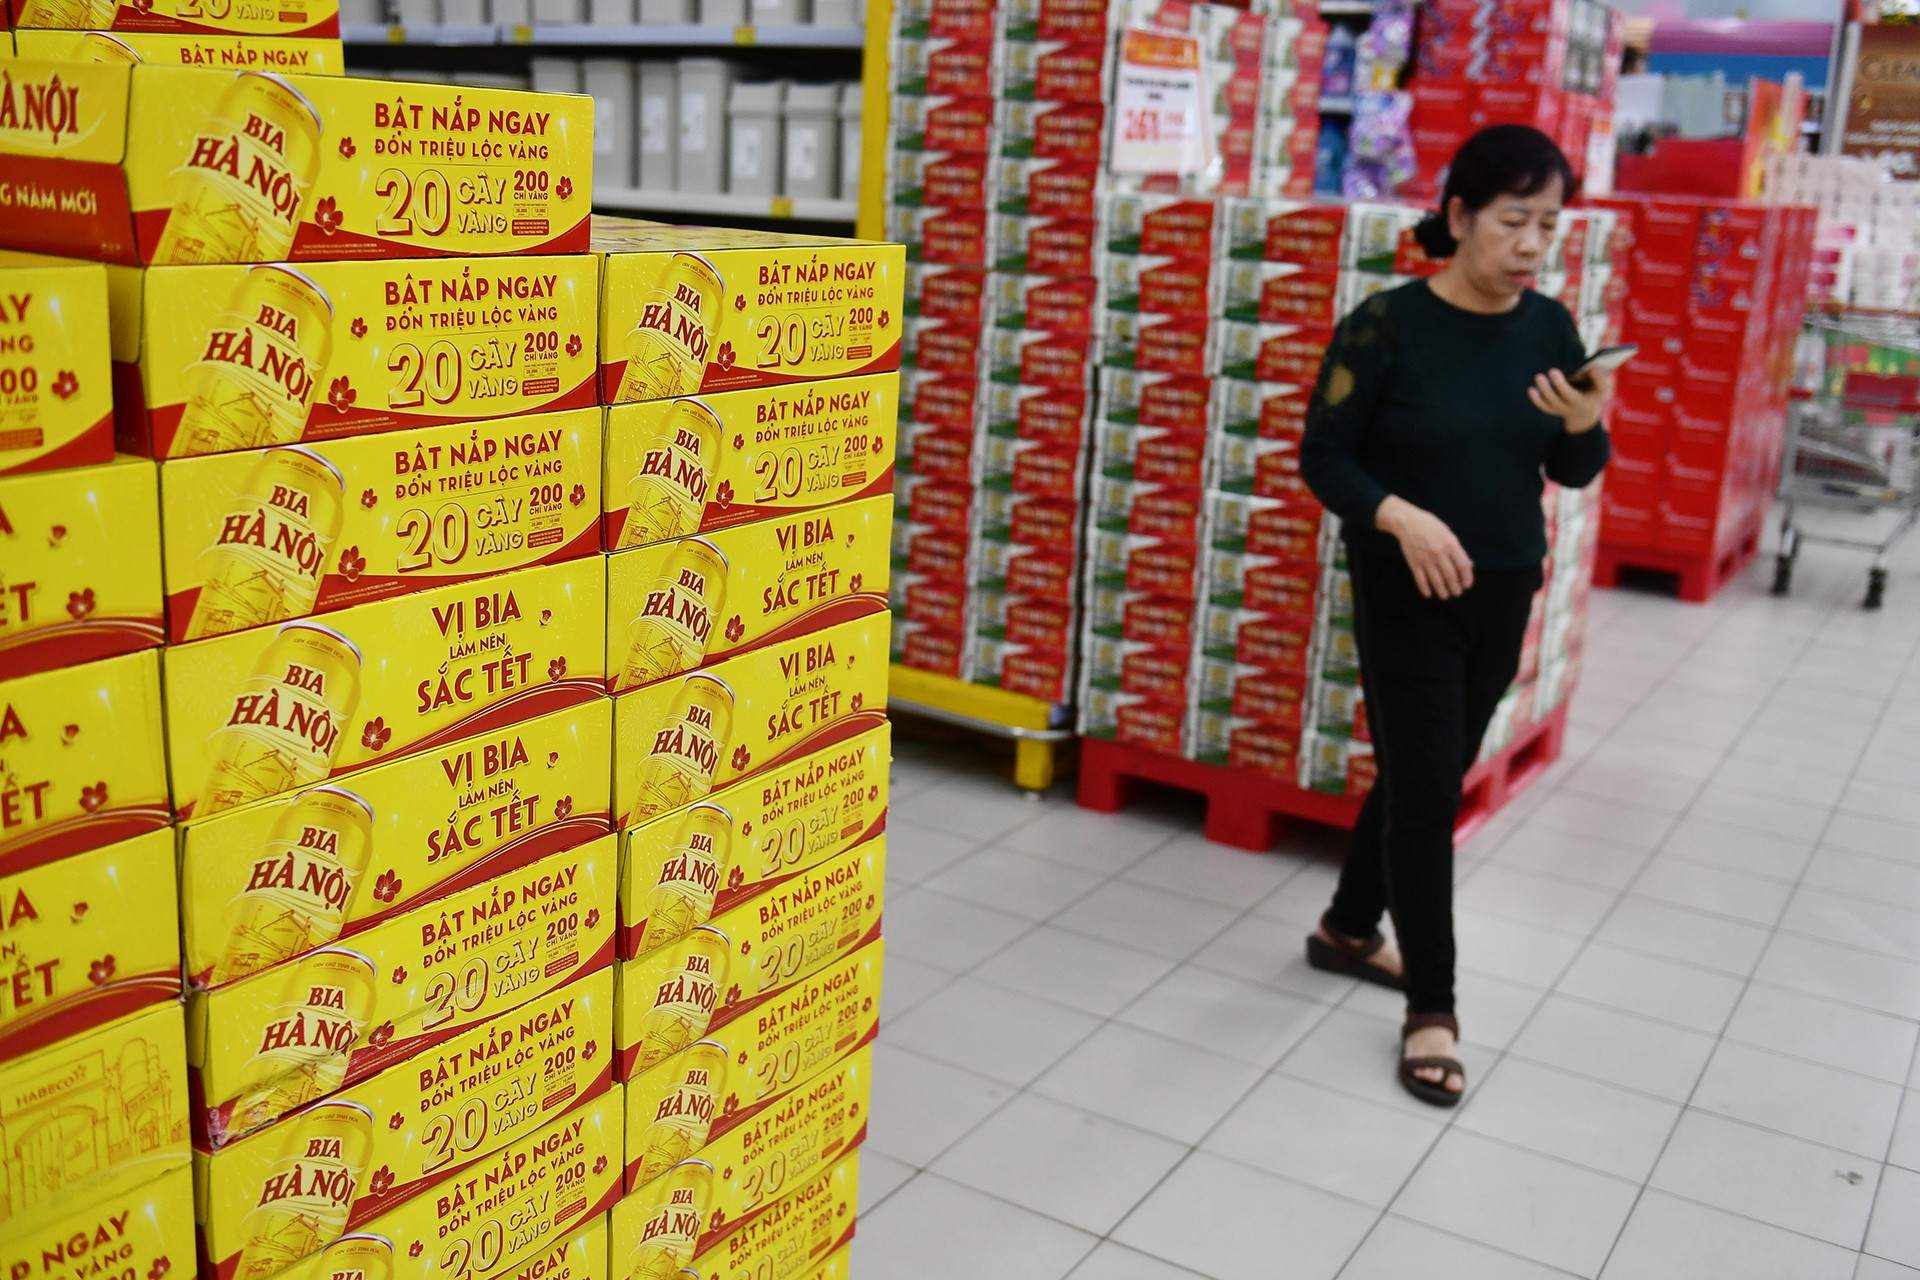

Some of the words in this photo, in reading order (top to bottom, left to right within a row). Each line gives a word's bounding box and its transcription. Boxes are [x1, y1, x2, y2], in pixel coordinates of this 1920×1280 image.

[264, 50, 309, 65] NGAY
[0, 69, 21, 130] À
[23, 72, 80, 146] NỘI
[375, 96, 424, 136] BẬT
[432, 94, 481, 132] NẮP
[488, 110, 550, 136] NGAY
[243, 114, 286, 155] BIA
[374, 134, 412, 155] ĐÓN
[419, 137, 465, 160] TRIỆU
[472, 138, 502, 162] LỘC
[508, 140, 549, 160] VÀNG
[188, 135, 242, 179] HÀ
[244, 155, 303, 223] NỘI
[454, 169, 507, 205] CÂY
[513, 169, 549, 192] 200
[375, 167, 451, 237] 20
[456, 207, 508, 234] VÀNG
[385, 273, 433, 312] BẬT
[442, 266, 490, 303] NẮP
[497, 275, 558, 300] NGAY
[759, 259, 791, 290] BẬT
[796, 254, 829, 283] NẮP
[833, 261, 876, 281] NGAY
[674, 284, 702, 312] BIA
[758, 289, 782, 305] ĐÓN
[787, 287, 818, 305] TRIỆU
[822, 286, 842, 304] LỘC
[846, 284, 874, 299] VÀNG
[256, 305, 299, 341] BIA
[385, 310, 423, 331] ĐÓN
[429, 307, 475, 330] TRIỆU
[481, 305, 512, 328] LỘC
[517, 303, 558, 322] VÀNG
[639, 301, 673, 334] HÀ
[674, 315, 710, 364] NỘI
[849, 306, 873, 325] 200
[465, 335, 517, 370] CÂY
[523, 330, 558, 353] 200
[203, 327, 256, 368] HÀ
[258, 344, 316, 405] NỘI
[386, 339, 462, 410] 20
[468, 372, 519, 400] VÀNG
[756, 397, 788, 427] BẬT
[793, 388, 825, 418] NẮP
[829, 390, 870, 413] NGAY
[395, 441, 442, 478] BẬT
[450, 429, 497, 467] NẮP
[504, 429, 564, 459] NGAY
[675, 429, 701, 455] BIA
[395, 477, 431, 499] ĐÓN
[438, 469, 482, 492] TRIỆU
[488, 464, 518, 486] LỘC
[524, 459, 563, 477] VÀNG
[528, 482, 563, 507] 200
[640, 447, 674, 478] HÀ
[674, 459, 709, 504] NỘI
[269, 485, 310, 518] BIA
[472, 493, 523, 528] CÂY
[217, 508, 268, 548] HÀ
[271, 522, 326, 578] NỘI
[396, 502, 469, 574] 20
[474, 529, 524, 557] VÀNG
[775, 524, 796, 554] VỊ
[803, 517, 834, 547] BIA
[785, 558, 803, 571] LÀM
[805, 552, 822, 566] NÊN
[678, 569, 705, 596] BIA
[763, 572, 800, 614] SẮC
[806, 561, 840, 601] TẾT
[431, 601, 464, 638] VỊ
[475, 590, 521, 628] BIA
[641, 587, 677, 619] HÀ
[676, 598, 713, 644] NỘI
[450, 642, 476, 660] LÀM
[479, 633, 505, 652] NÊN
[779, 652, 800, 681] VỊ
[806, 641, 836, 672] BIA
[282, 664, 325, 696] BIA
[417, 661, 473, 713] SẮC
[481, 644, 533, 693] TẾT
[227, 688, 281, 727] HÀ
[283, 701, 340, 756] NỘI
[686, 706, 712, 730] BIA
[767, 699, 803, 740] SẮC
[809, 684, 841, 723] TẾT
[441, 751, 473, 787] VỊ
[484, 736, 529, 776] BIA
[651, 724, 685, 755] HÀ
[684, 734, 720, 776] NỘI
[459, 789, 484, 808] LÀM
[488, 778, 513, 798] NÊN
[763, 779, 791, 807] BẬT
[829, 746, 866, 778] NGAY
[0, 772, 50, 829] ẾT
[298, 827, 339, 855] BIA
[427, 810, 481, 863] SẮC
[490, 788, 540, 838] TẾT
[690, 834, 713, 853] BIA
[244, 851, 296, 892] HÀ
[298, 862, 353, 912] NỘI
[659, 852, 688, 884] HÀ
[689, 860, 720, 894] NỘI
[422, 911, 465, 948] BẬT
[472, 886, 517, 927] NẮP
[523, 864, 580, 905] NGAY
[421, 943, 455, 969] ĐÓN
[460, 923, 502, 951] TRIỆU
[508, 909, 536, 932] LỘC
[541, 891, 579, 915] VÀNG
[546, 912, 578, 941] 200
[686, 956, 710, 974] BIA
[308, 986, 345, 1009] BIA
[421, 957, 490, 1034] 20
[655, 975, 685, 1008] HÀ
[686, 981, 717, 1013] NỘI
[261, 1010, 307, 1053] HÀ
[419, 1054, 462, 1093] BẬT
[470, 1027, 514, 1068] NẮP
[520, 998, 577, 1043] NGAY
[419, 1086, 452, 1113] ĐÓN
[458, 1062, 500, 1092] TRIỆU
[506, 1046, 534, 1070] LỘC
[539, 1025, 576, 1051] VÀNG
[543, 1045, 576, 1076] 200
[686, 1070, 709, 1086] BIA
[655, 1089, 684, 1122] HÀ
[685, 1093, 716, 1124] NỘI
[306, 1138, 343, 1158] BIA
[419, 1098, 487, 1176] 20
[260, 1163, 305, 1207] HÀ
[307, 1167, 357, 1207] NỘI
[437, 1179, 478, 1220] BẬT
[485, 1151, 527, 1192] NẮP
[533, 1117, 587, 1164] NGAY
[671, 1189, 694, 1205] BIA
[42, 1209, 130, 1273] NGAY
[641, 1209, 670, 1244] HÀ
[671, 1211, 702, 1242] NỘI
[75, 1243, 133, 1280] VÀNG
